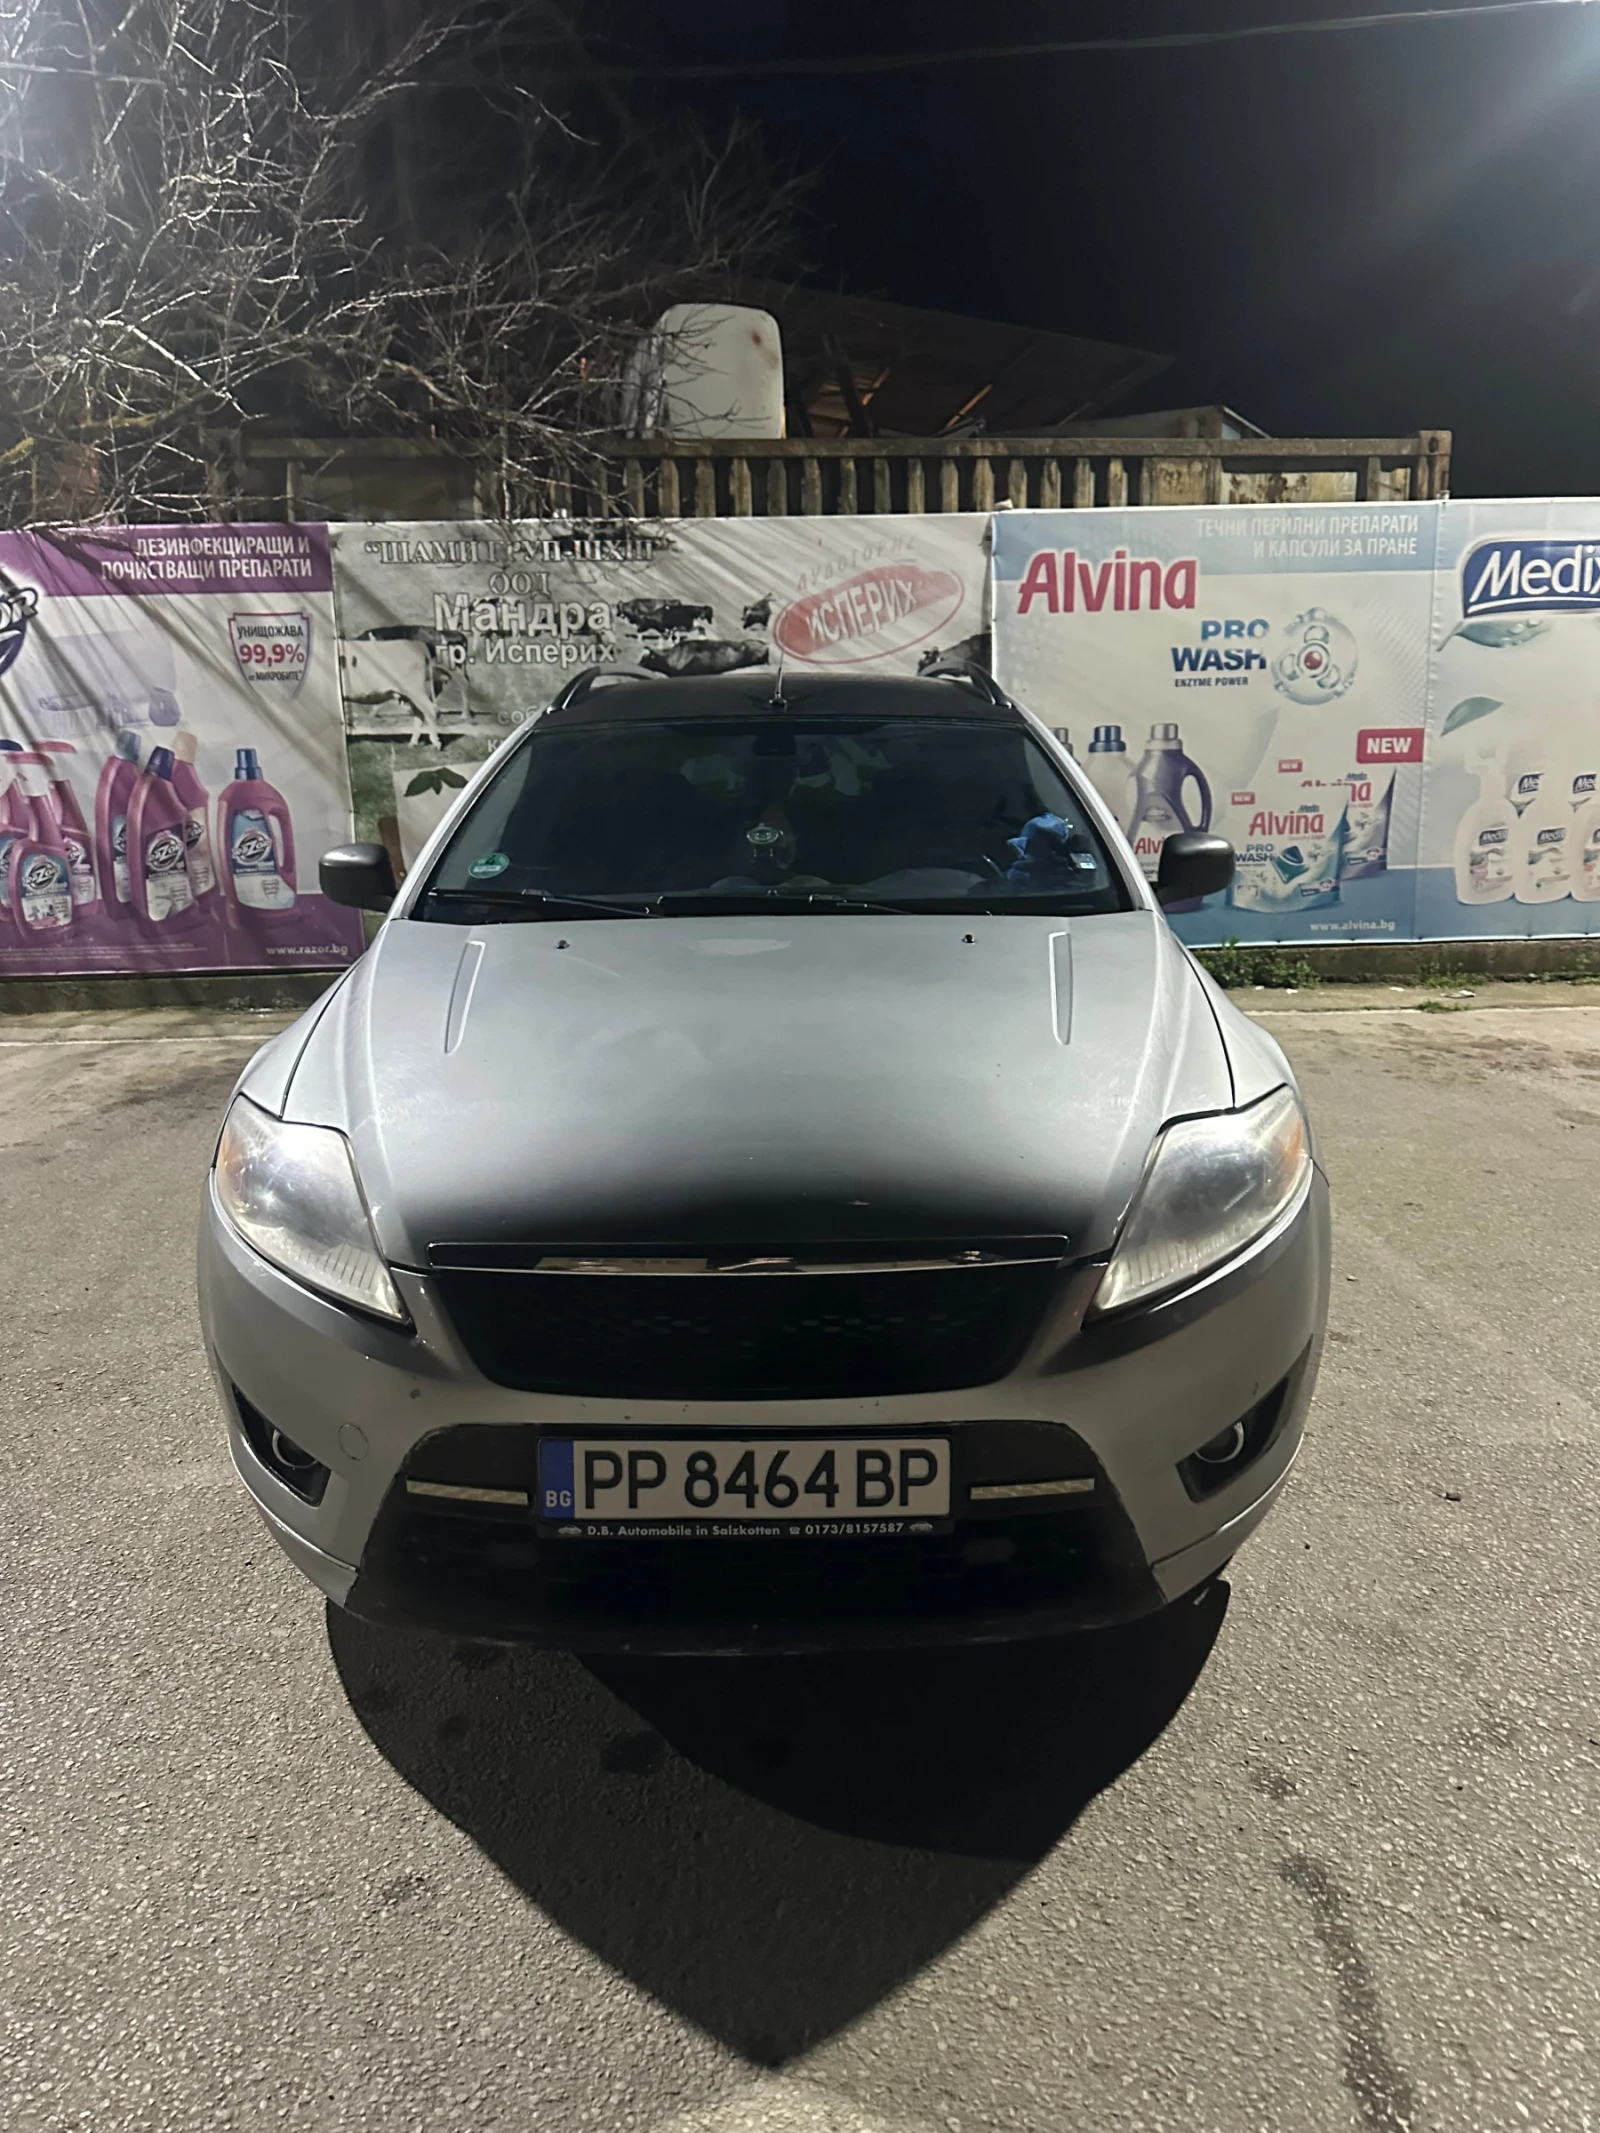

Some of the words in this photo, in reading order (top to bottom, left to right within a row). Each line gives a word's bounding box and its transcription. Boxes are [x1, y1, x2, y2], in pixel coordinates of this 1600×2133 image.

[1198, 518, 1247, 537] ТЕЧНИ
[1251, 516, 1325, 536] ПЕРИЛНИ
[1329, 514, 1418, 535] ПРЕПАРАТИ
[136, 536, 294, 558] ДЕЗИНФЕКЦИРАЩИ
[298, 537, 310, 553] И
[1253, 541, 1264, 557] И
[1267, 539, 1341, 557] КАПСУЛИ
[1343, 539, 1363, 556] ЗА
[1366, 538, 1417, 555] ПРАНЕ
[101, 561, 216, 581] ПОЧИСТВАЩИ
[219, 559, 312, 578] ПРЕПАРАТИ
[1017, 550, 1197, 614] Alvina
[434, 593, 614, 640] Мандра
[805, 579, 918, 642] ИСПЕРИХ
[237, 626, 304, 639] УНИЩОЖАВА
[1201, 619, 1269, 641] PRO
[239, 644, 305, 667] 99,9%
[435, 647, 475, 663] гр.
[485, 640, 617, 668] Исперих
[1171, 647, 1267, 671] WASH
[1175, 678, 1212, 687] ENZYME
[1215, 677, 1249, 686] POWER
[1367, 737, 1412, 754] NEW
[1249, 811, 1324, 836] Alvina
[1235, 853, 1272, 862] WASH
[1247, 844, 1274, 852] PRO
[1310, 920, 1396, 931] www.alvina.bg
[265, 943, 348, 956] www.razor.bg
[584, 1450, 667, 1509] PP
[684, 1450, 839, 1508] 8464
[856, 1449, 938, 1507] BP
[545, 1490, 572, 1508] BG
[587, 1526, 614, 1536] D.B.
[618, 1526, 692, 1536] Automobile
[696, 1526, 708, 1536] in
[712, 1525, 780, 1536] Salzkotten
[805, 1523, 904, 1536] 0173/8157587
